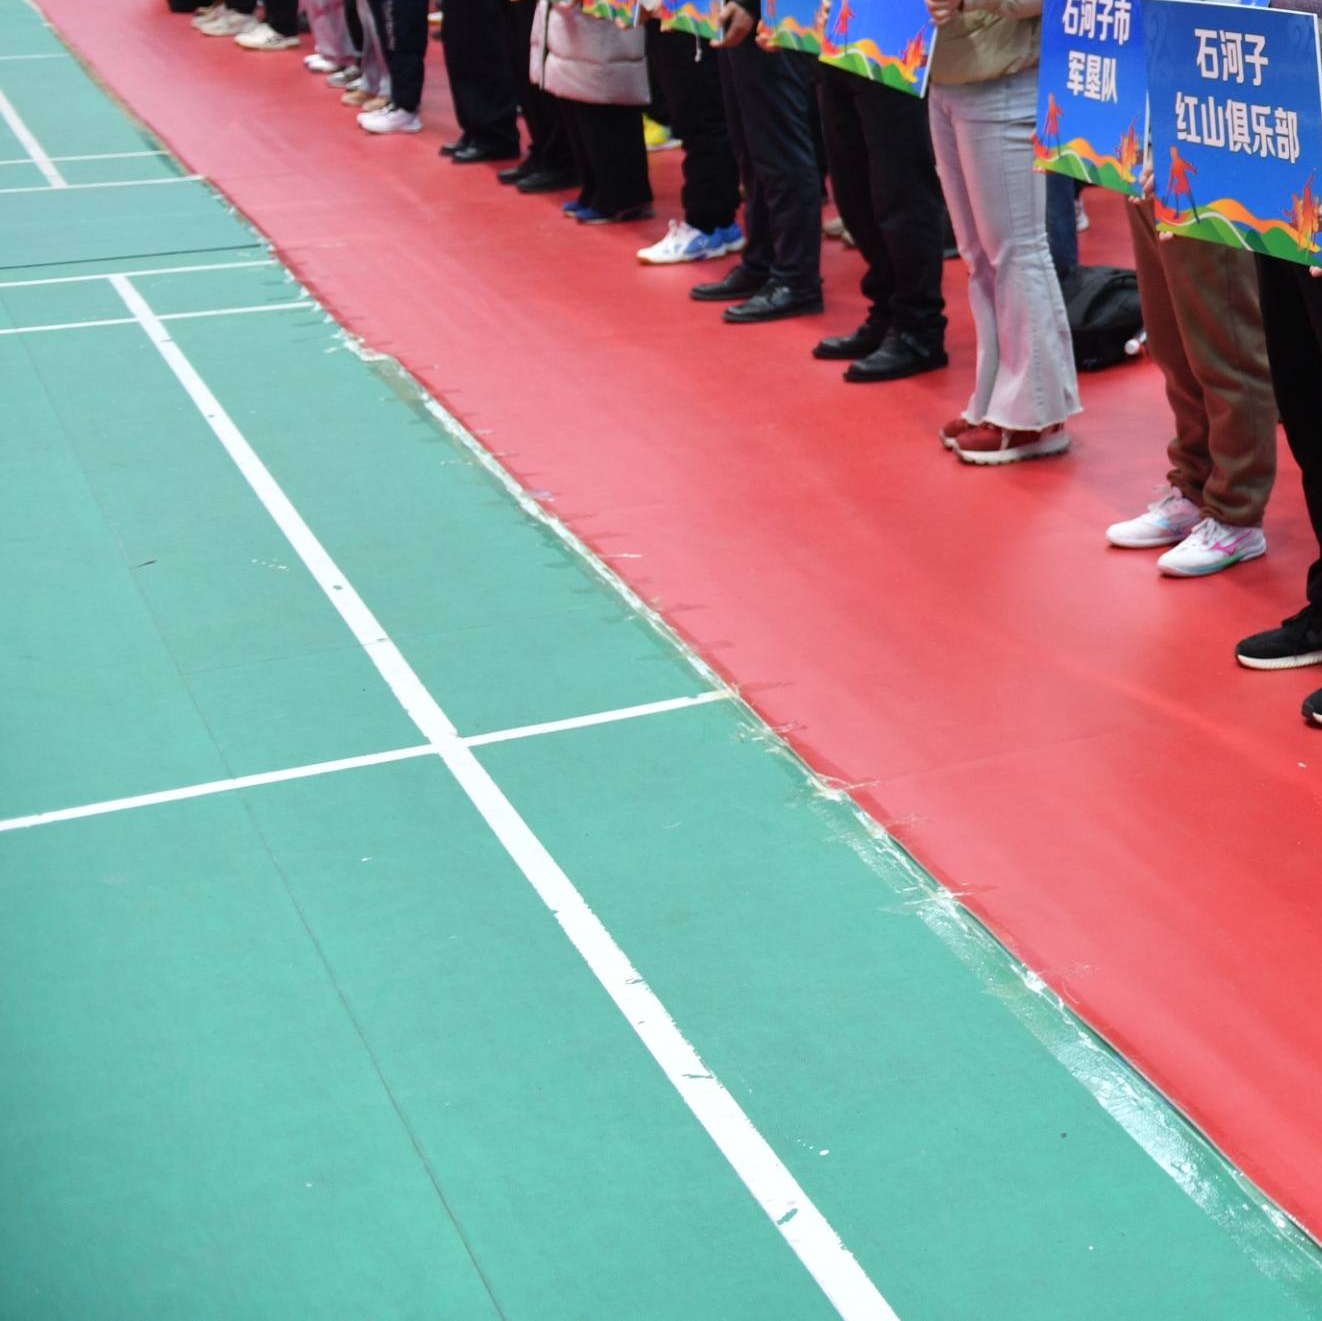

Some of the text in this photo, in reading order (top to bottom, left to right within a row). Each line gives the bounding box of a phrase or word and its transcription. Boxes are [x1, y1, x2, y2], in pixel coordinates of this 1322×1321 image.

[1066, 50, 1119, 104] 军垦队
[1194, 27, 1269, 87] 石河子
[1174, 91, 1301, 164] 红山俱乐部
